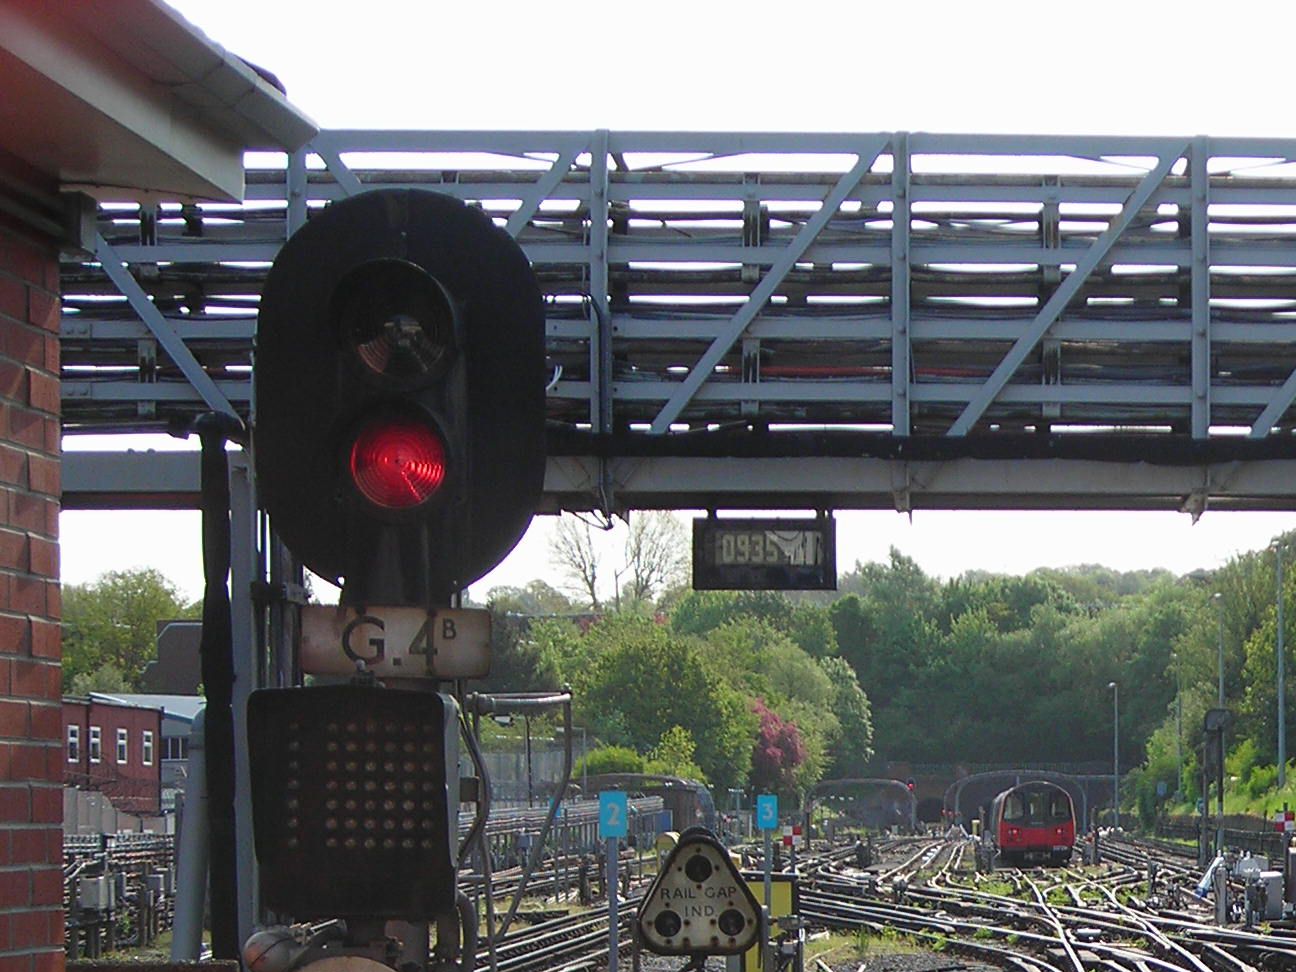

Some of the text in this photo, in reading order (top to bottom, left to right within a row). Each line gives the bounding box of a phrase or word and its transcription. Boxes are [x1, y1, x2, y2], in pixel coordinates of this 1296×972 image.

[606, 802, 620, 826] 2
[762, 803, 774, 820] 3
[660, 886, 737, 900] RAIL GAP
